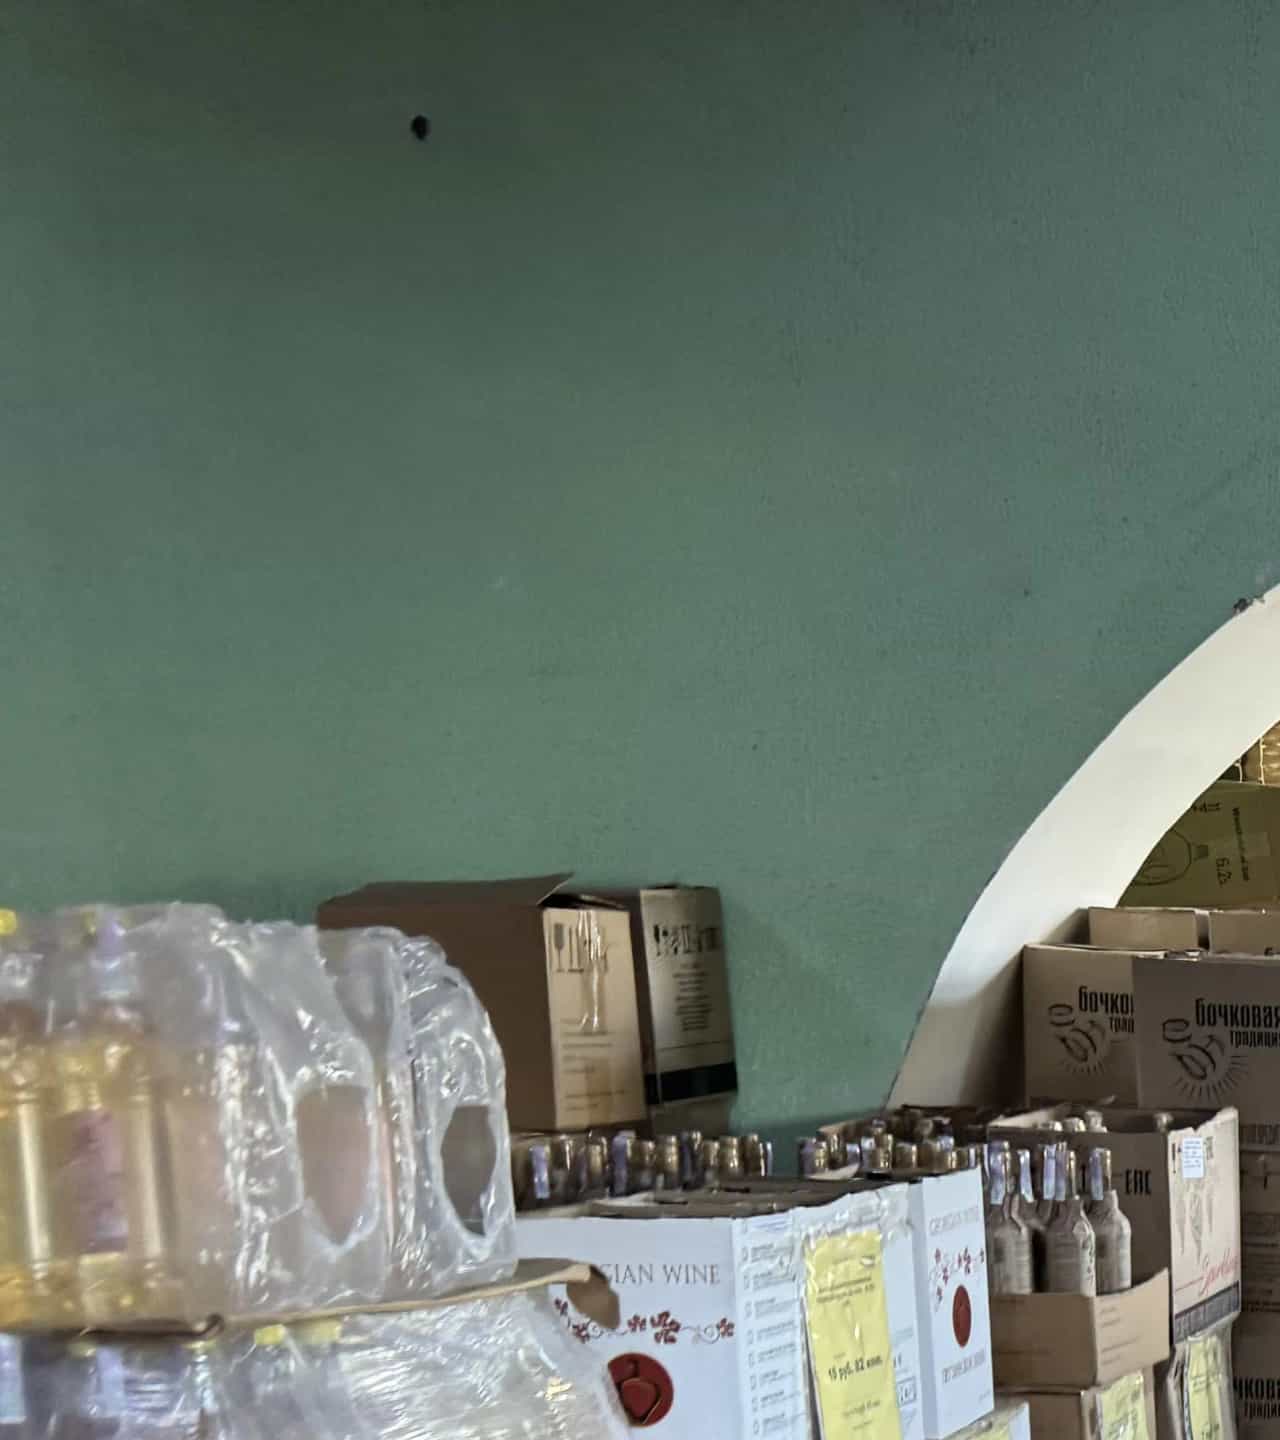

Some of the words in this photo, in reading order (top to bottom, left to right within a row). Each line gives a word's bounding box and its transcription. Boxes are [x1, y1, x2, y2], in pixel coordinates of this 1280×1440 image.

[1078, 985, 1134, 1015] бочко
[1108, 1016, 1135, 1034] трад
[662, 1263, 721, 1286] WINE
